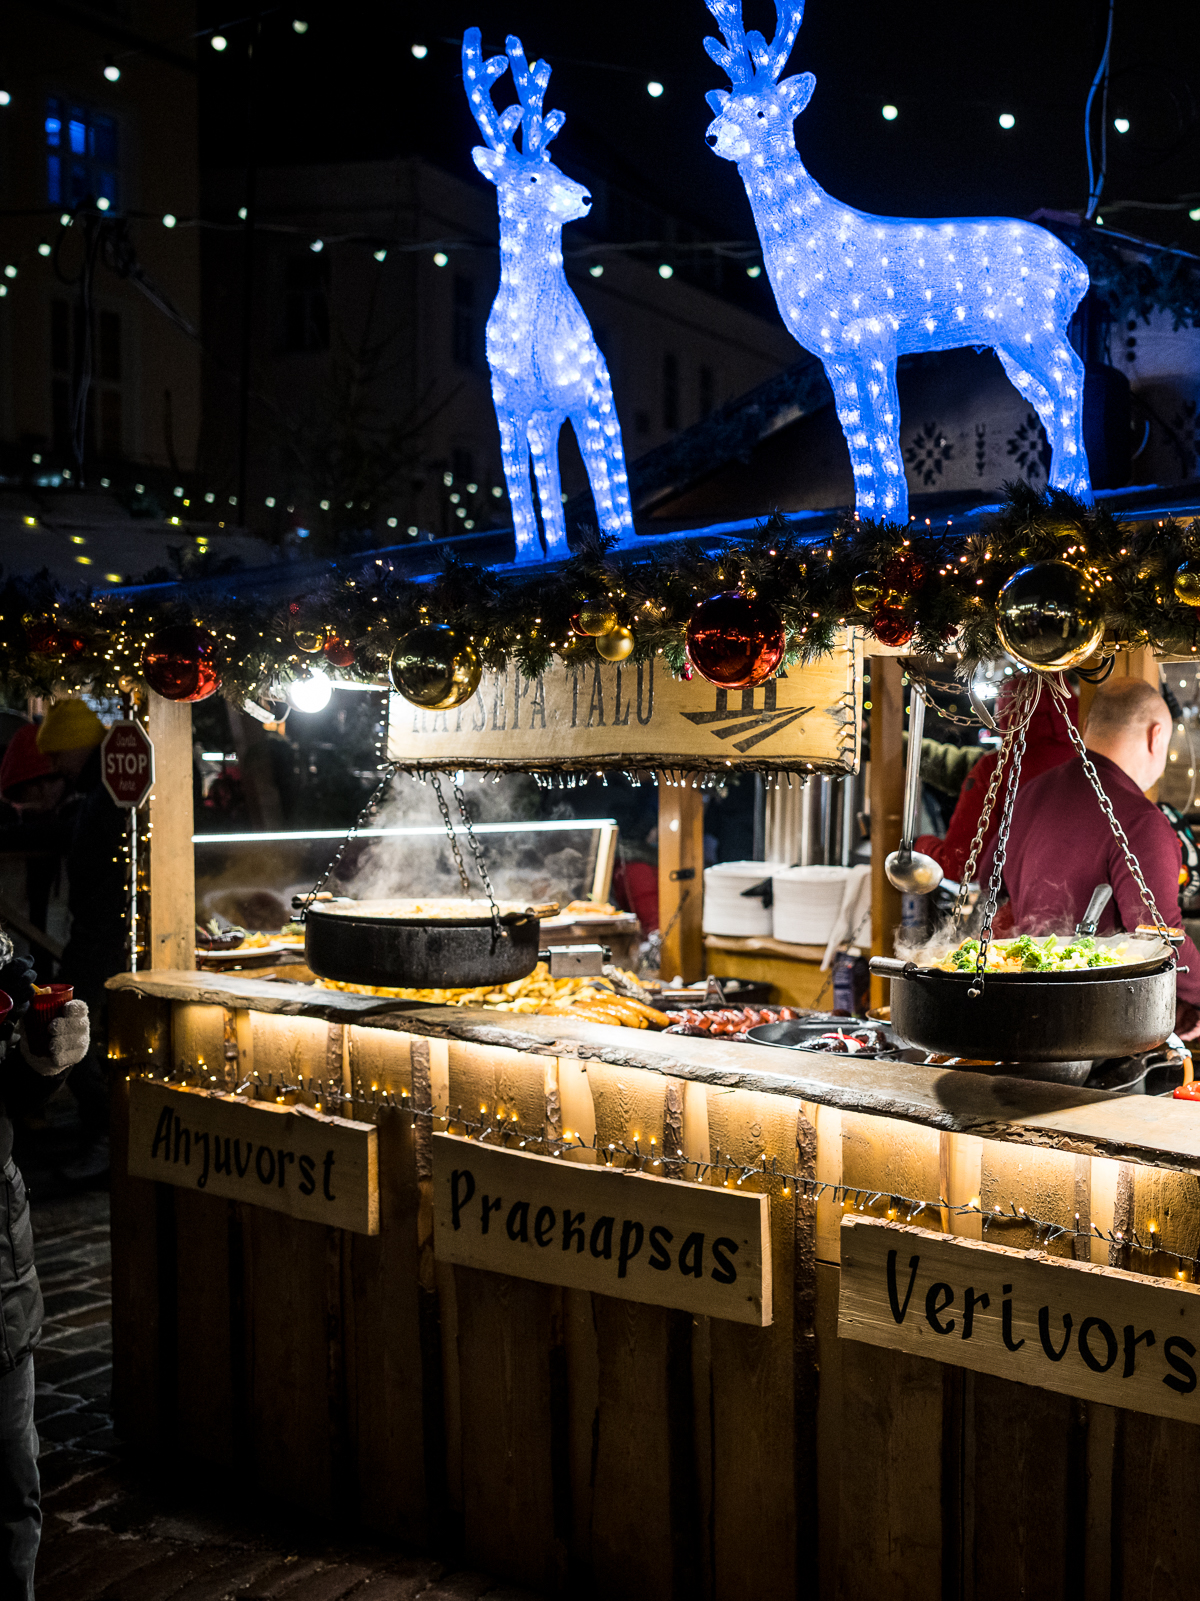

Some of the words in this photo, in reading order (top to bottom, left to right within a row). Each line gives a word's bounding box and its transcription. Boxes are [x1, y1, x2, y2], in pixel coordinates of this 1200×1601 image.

[565, 657, 655, 729] TALU
[117, 733, 137, 747] Santa
[107, 754, 148, 774] STOP
[119, 778, 136, 791] here
[151, 1105, 336, 1201] Ahjuvorst
[449, 1168, 740, 1285] Praekapsas
